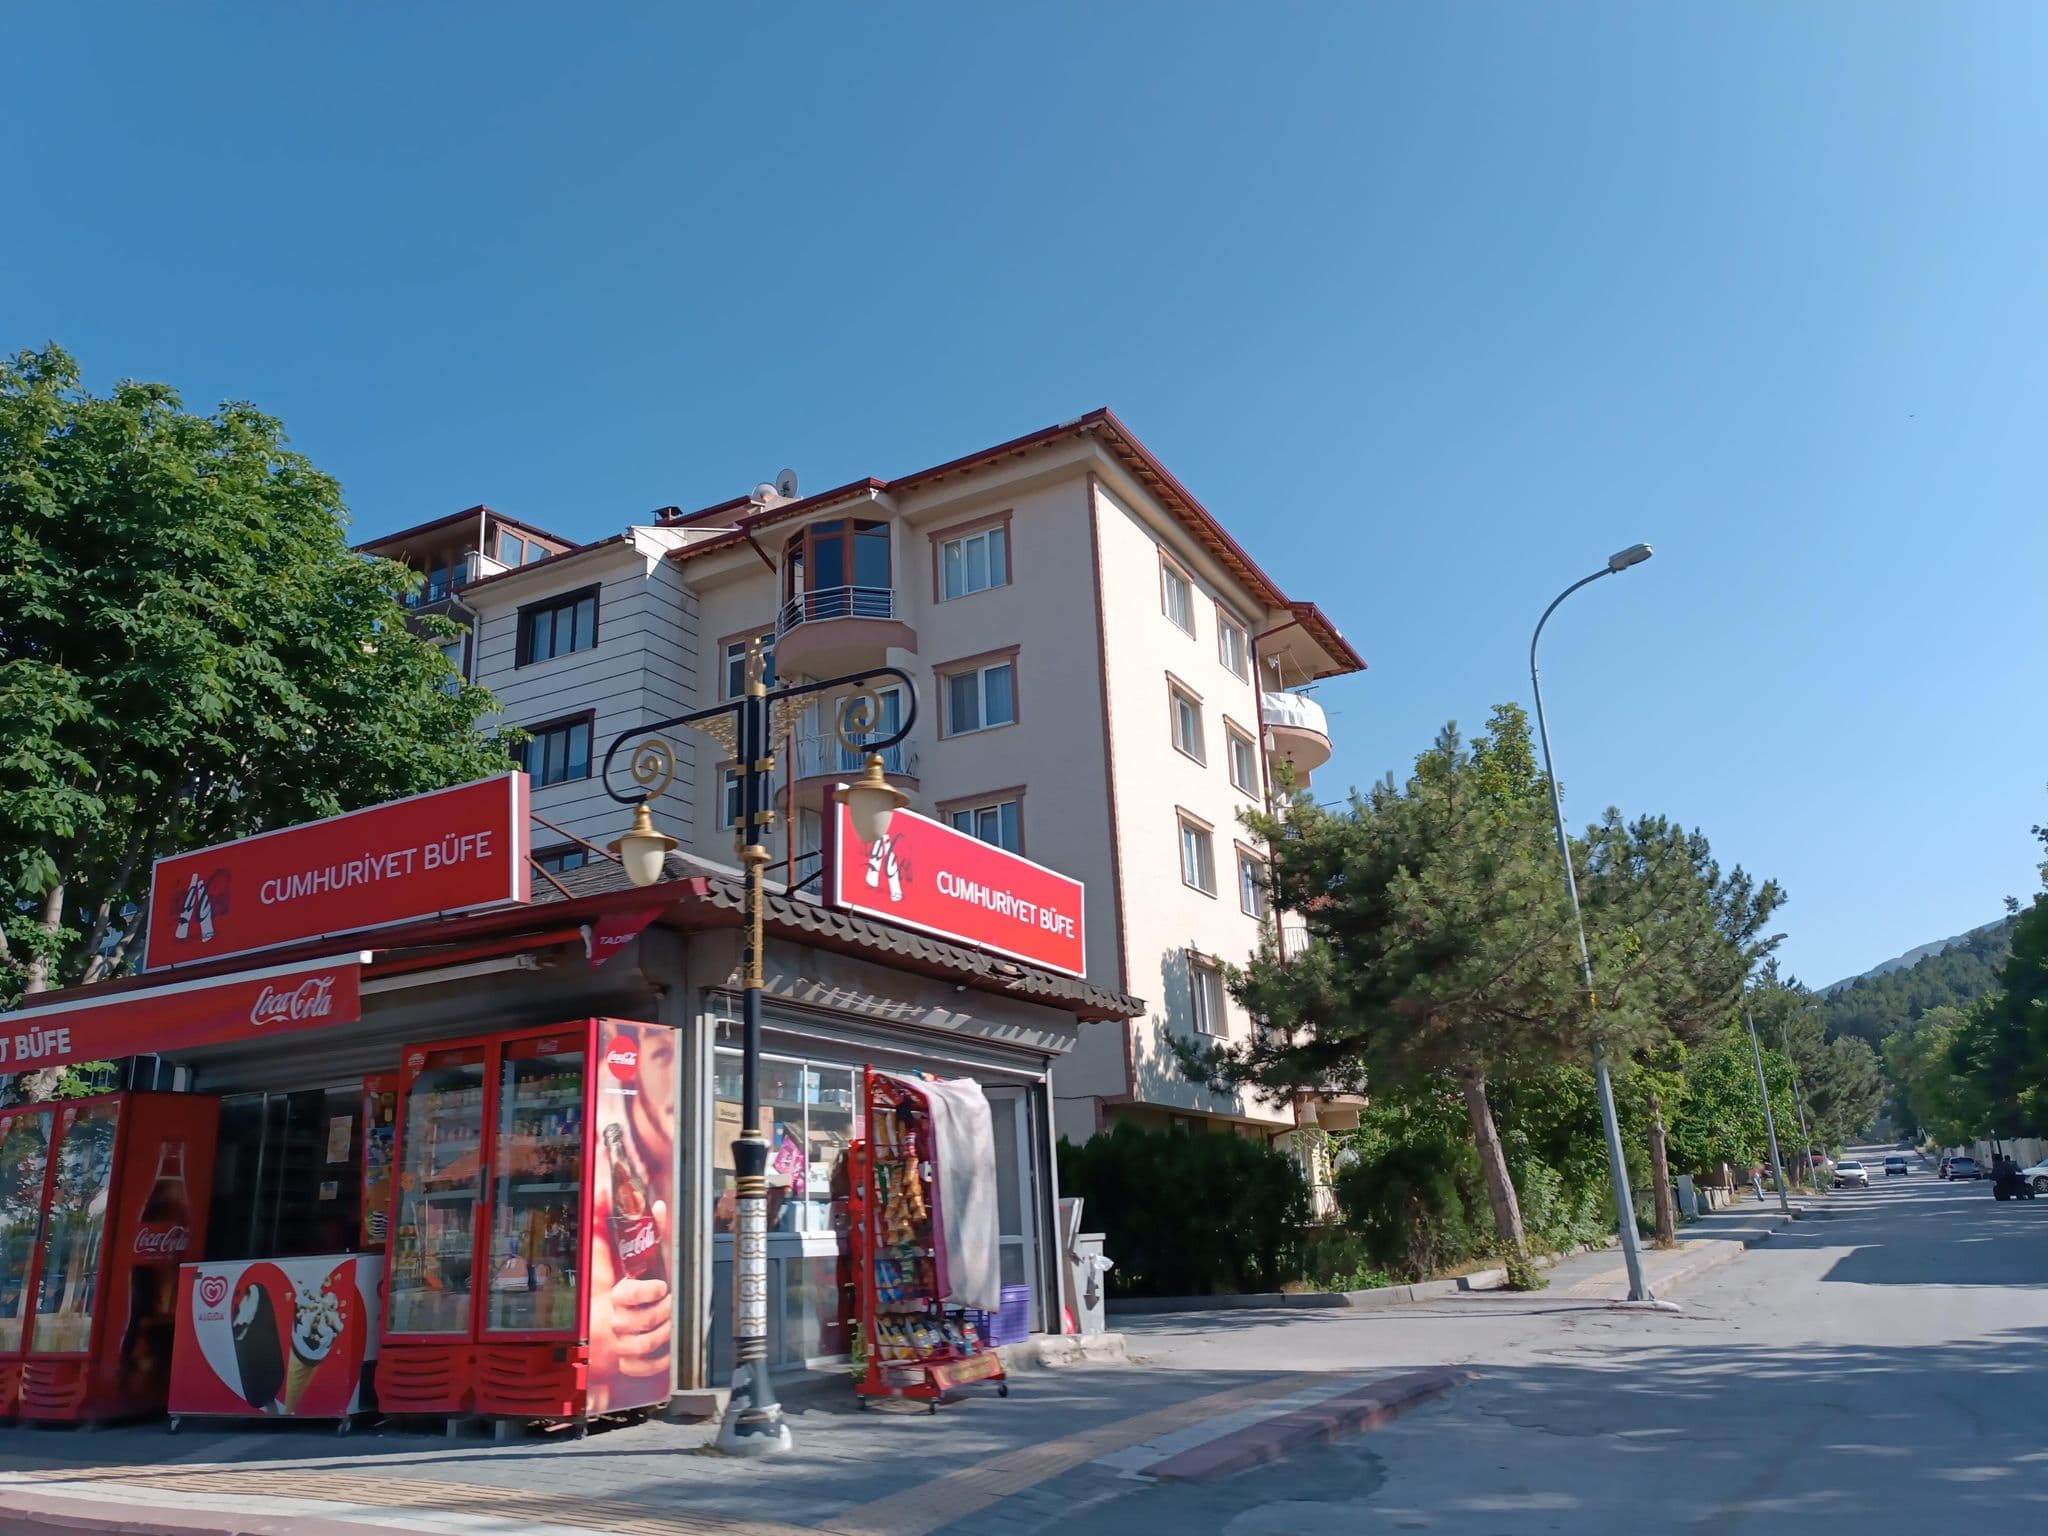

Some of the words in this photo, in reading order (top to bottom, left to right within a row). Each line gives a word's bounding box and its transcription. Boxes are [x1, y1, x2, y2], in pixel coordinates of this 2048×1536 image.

[260, 847, 417, 905] CUMHURİYET
[423, 830, 493, 871] BÜFE
[936, 871, 1037, 924] CUMHURİYET
[1039, 906, 1075, 939] BÜFE
[14, 1026, 72, 1061] BÜFE
